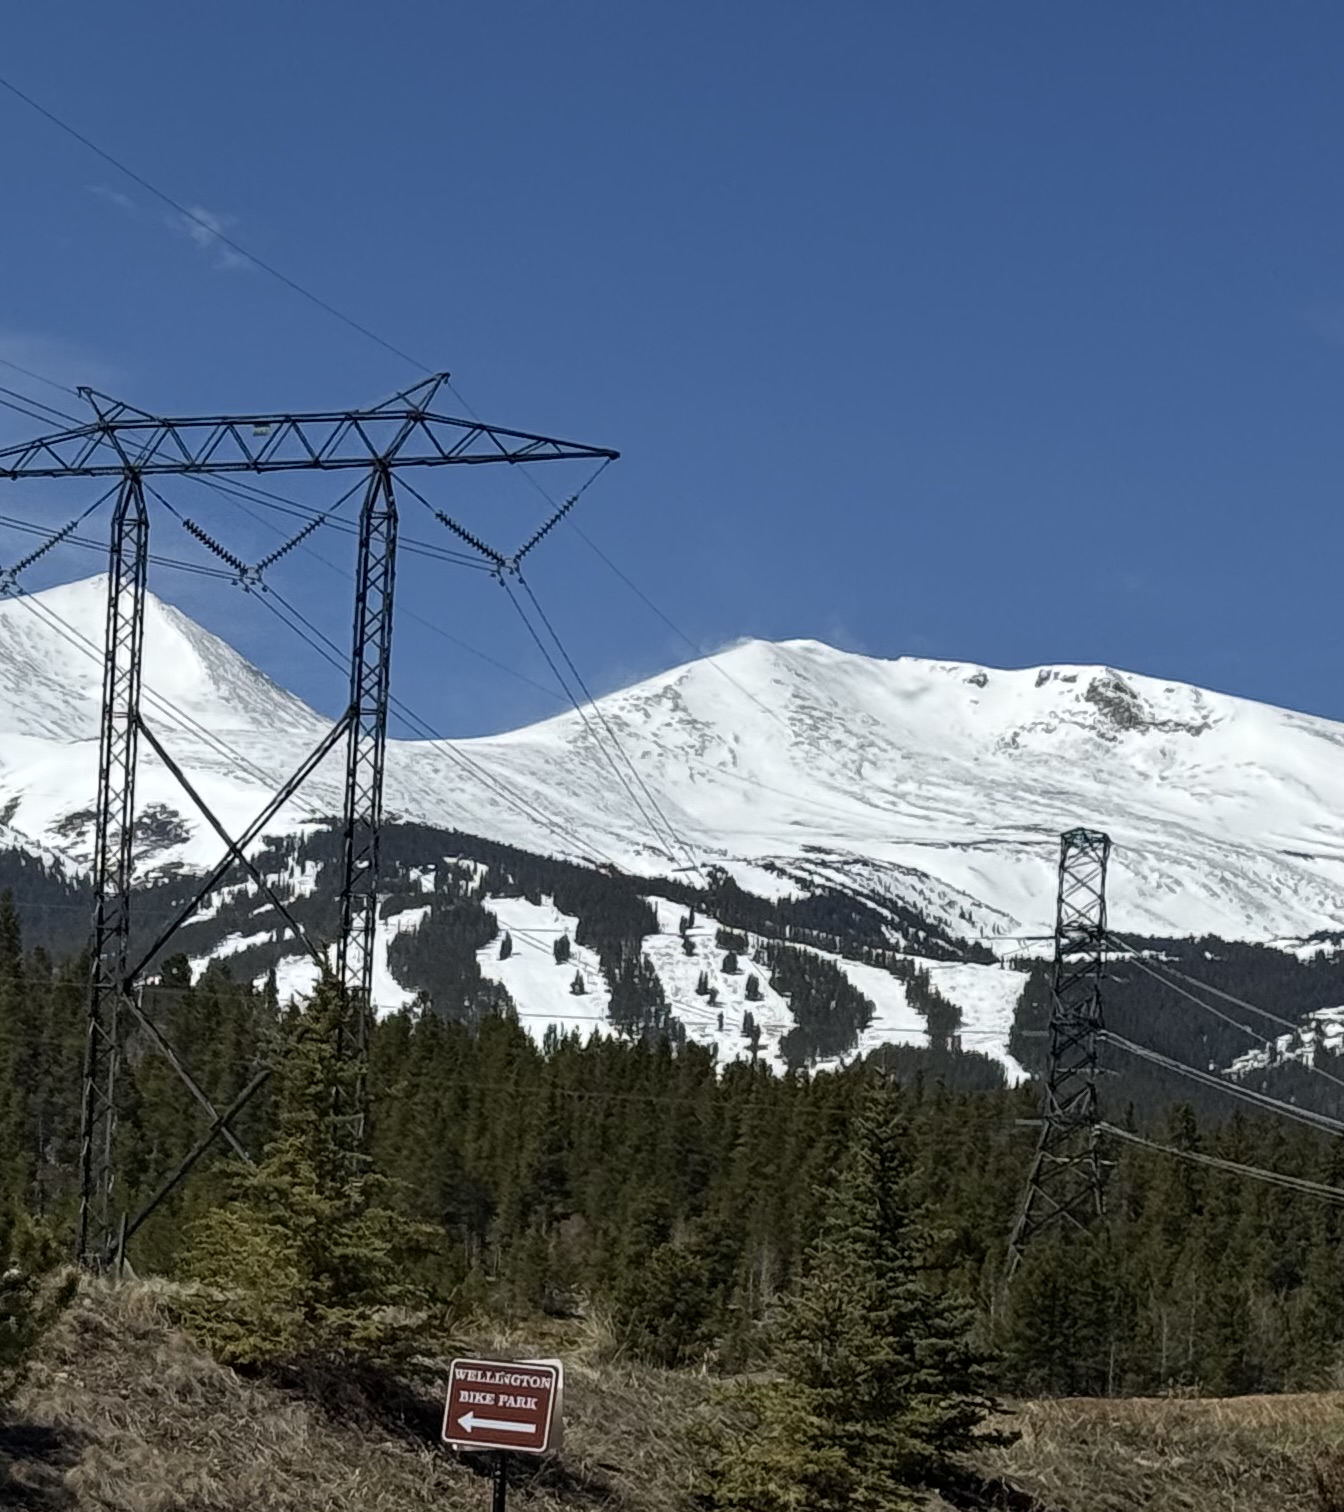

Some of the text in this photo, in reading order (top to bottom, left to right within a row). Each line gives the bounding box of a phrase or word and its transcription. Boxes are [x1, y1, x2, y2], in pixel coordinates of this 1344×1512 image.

[454, 1368, 552, 1389] WELLINGTON
[459, 1390, 539, 1410] BIKE PARK
